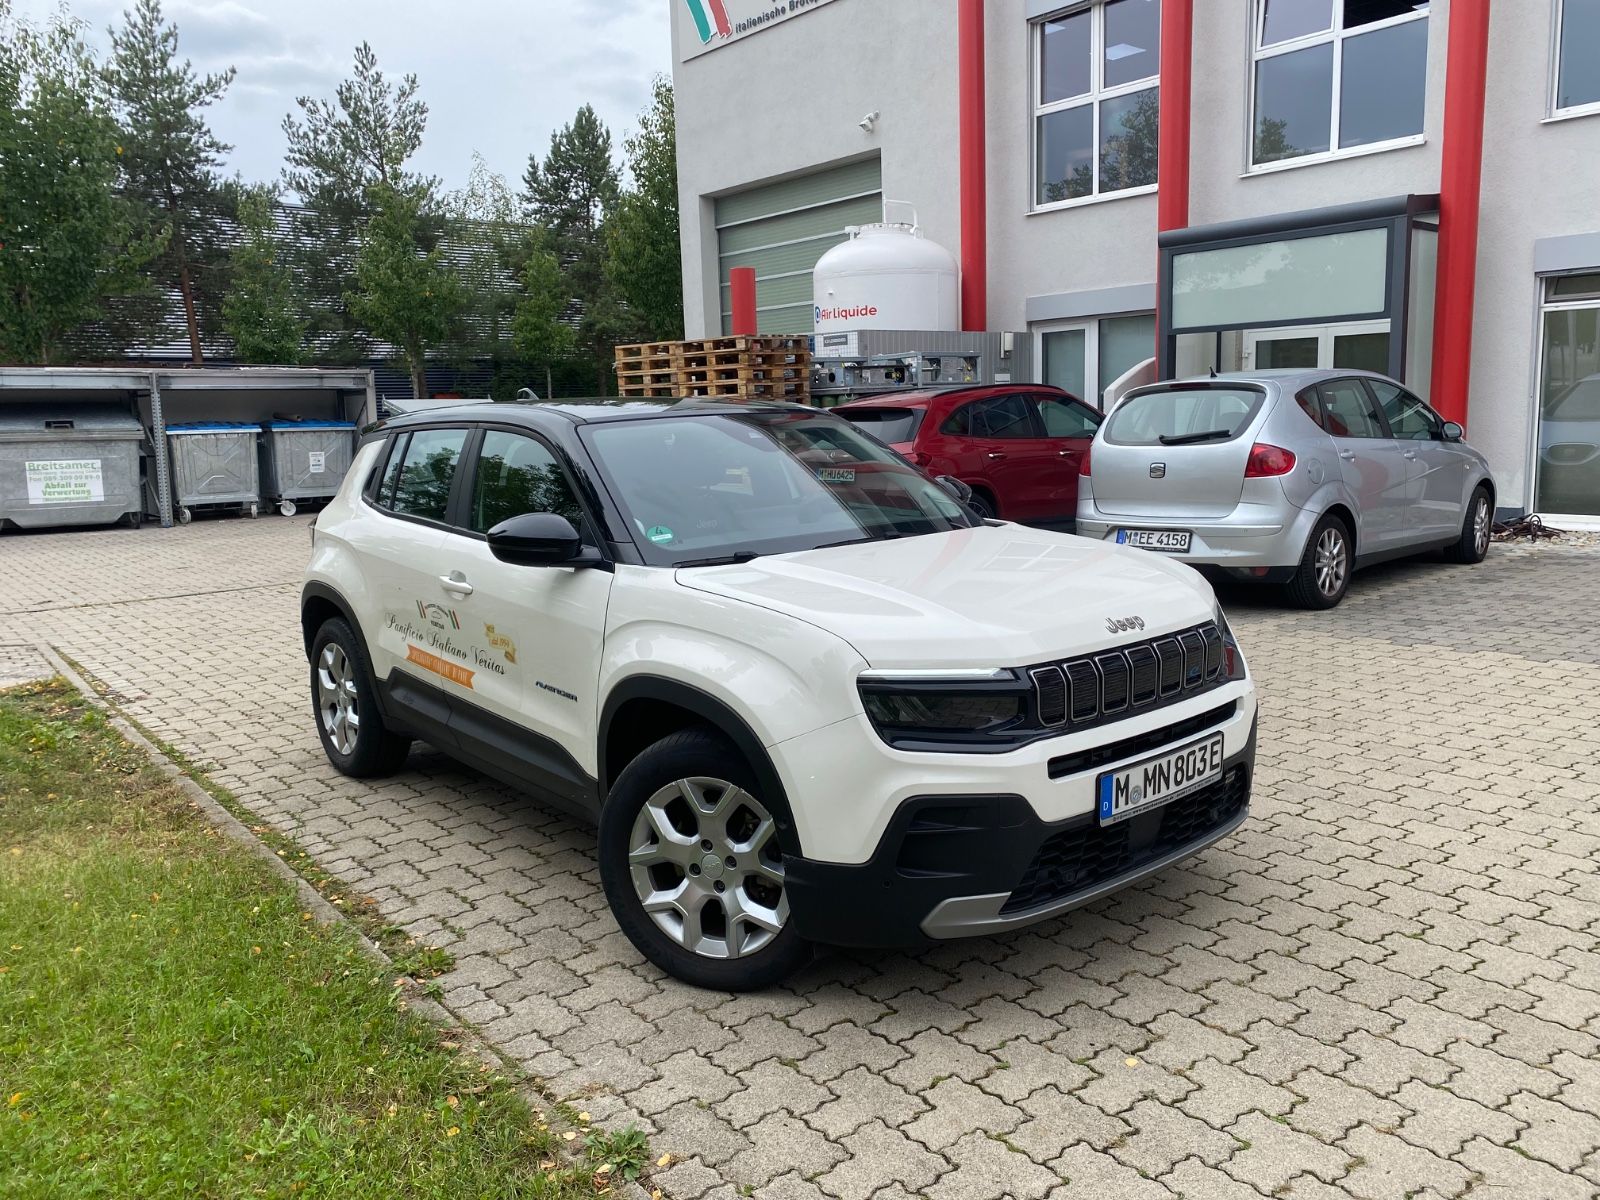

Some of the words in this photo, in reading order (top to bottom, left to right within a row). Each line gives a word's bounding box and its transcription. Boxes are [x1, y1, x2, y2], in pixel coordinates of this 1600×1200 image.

[735, 6, 786, 33] italienische
[821, 309, 832, 320] Air
[833, 305, 878, 320] Liquide
[27, 462, 97, 471] Breitsamer
[41, 488, 91, 497] Verwertung
[1124, 531, 1132, 544] M
[1139, 532, 1154, 545] EE
[1156, 533, 1187, 547] 4158
[1104, 615, 1145, 634] Jeep
[385, 612, 424, 642] Panificio
[427, 629, 467, 660] Italiano
[470, 644, 505, 675] Veritas
[1114, 773, 1130, 810] M
[1102, 801, 1109, 811] D
